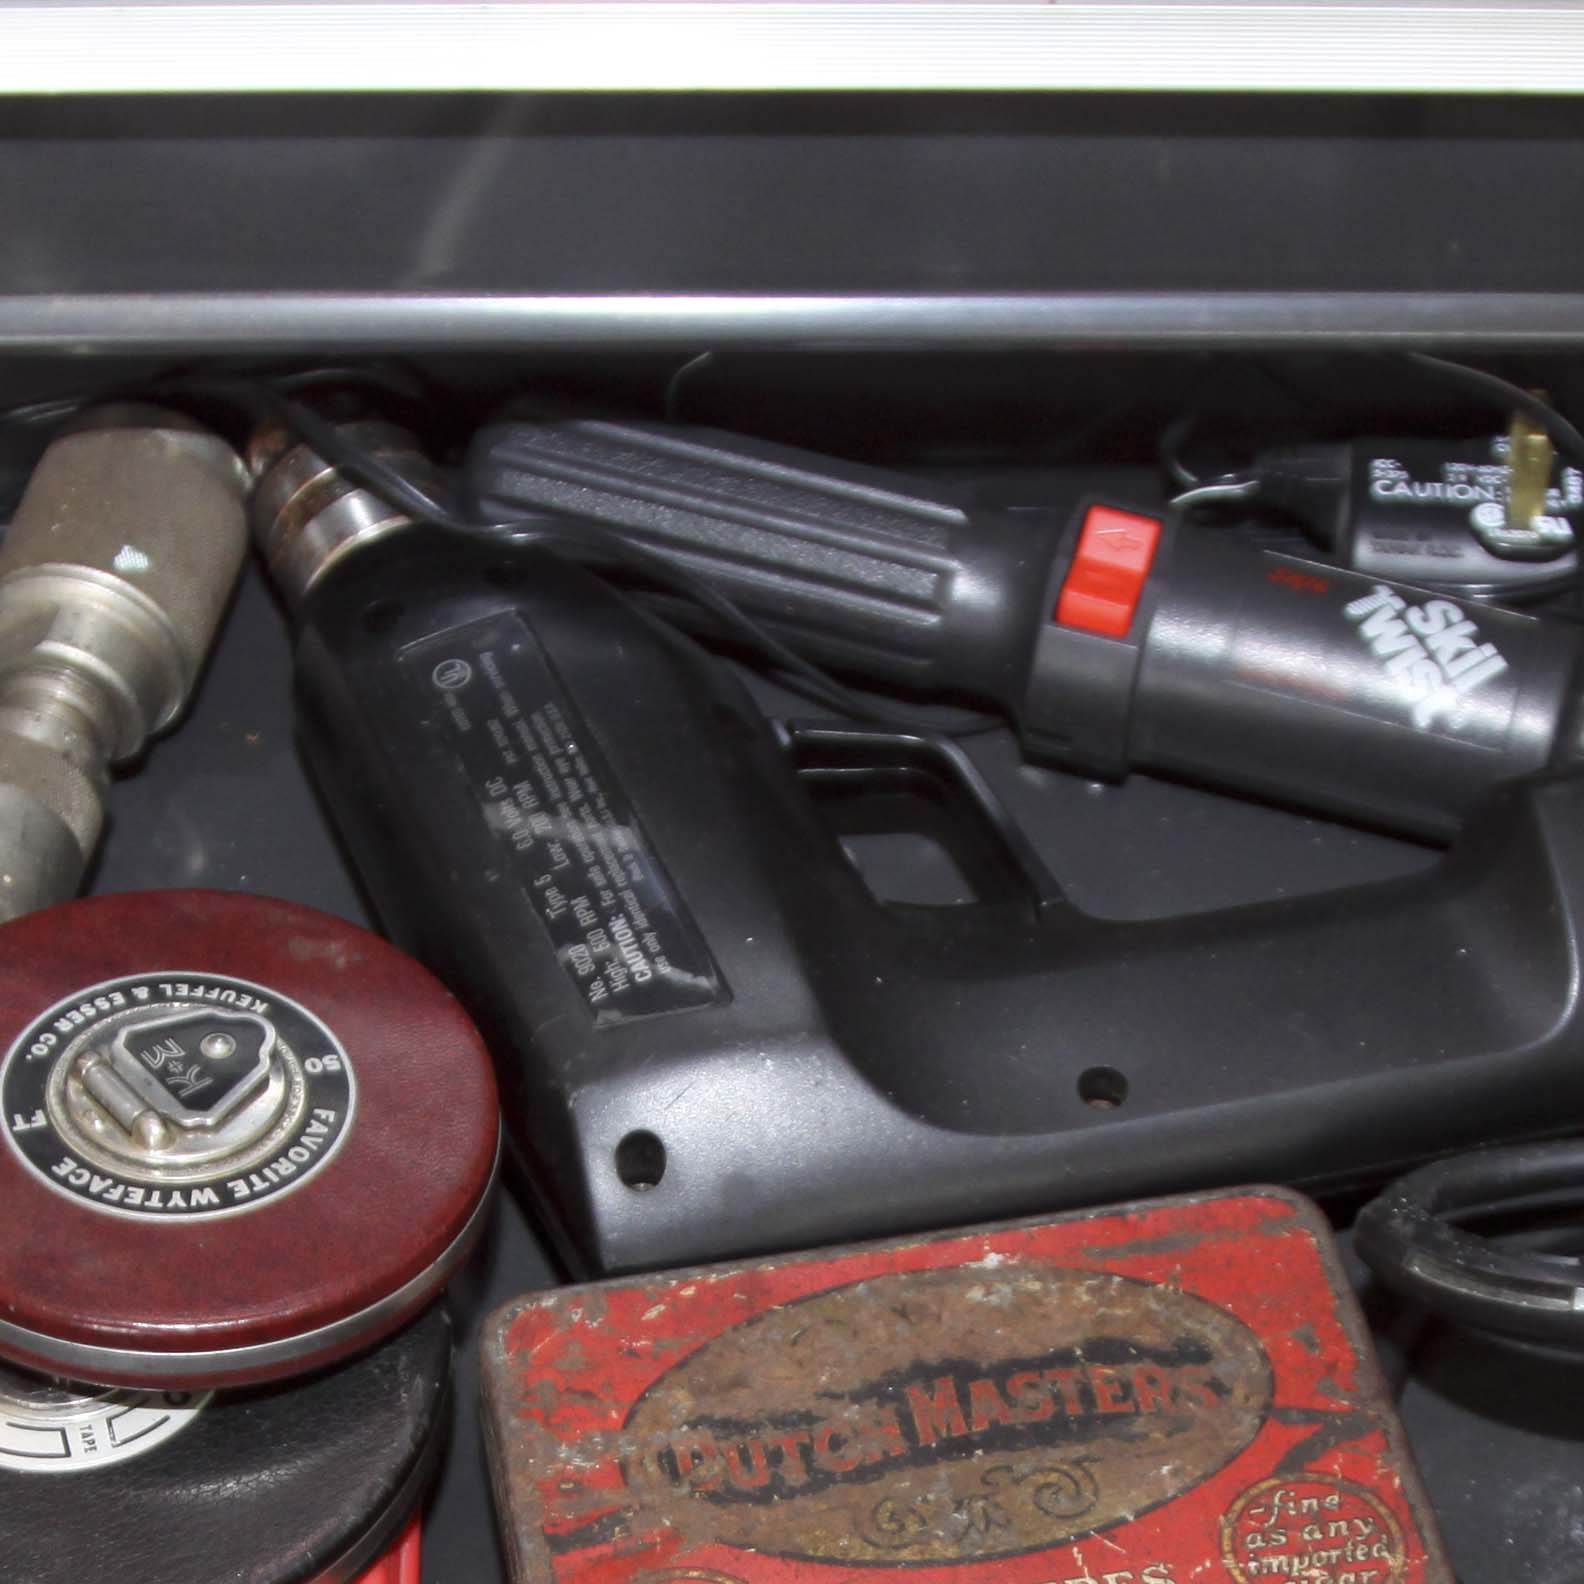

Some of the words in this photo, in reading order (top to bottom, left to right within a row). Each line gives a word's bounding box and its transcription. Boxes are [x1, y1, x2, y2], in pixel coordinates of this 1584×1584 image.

[483, 774, 508, 798] DC
[512, 779, 539, 810] RPM
[584, 863, 607, 888] safe
[538, 884, 571, 919] Type
[569, 893, 598, 927] RPM
[596, 888, 616, 907] For
[618, 888, 648, 930] identical
[606, 912, 653, 983] CAUTION:
[639, 929, 662, 954] only
[130, 985, 150, 1000] &
[159, 982, 270, 1014] KEUFFEL
[53, 991, 129, 1033] ESSER
[25, 1032, 57, 1062] CO.
[304, 1054, 341, 1074] 50
[12, 1109, 47, 1131] FT
[227, 1107, 336, 1200] FAVORITE
[50, 1155, 220, 1208] WYTEFACE
[904, 1364, 1217, 1446] MASTERS
[79, 1423, 98, 1454] TAPE
[1245, 1528, 1288, 1549] as
[1247, 1534, 1393, 1577] imported
